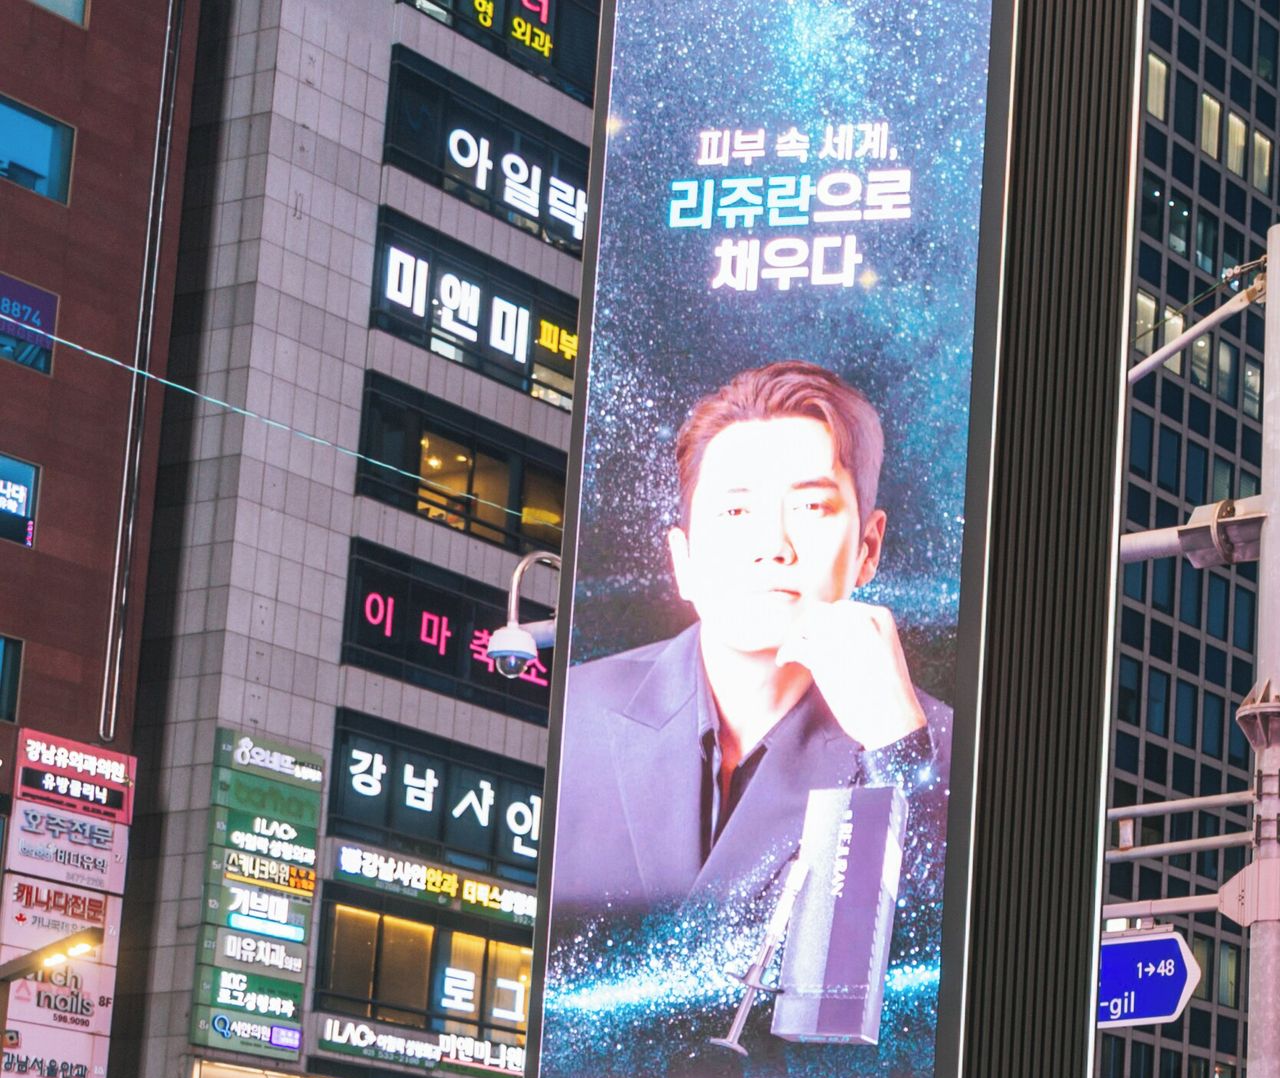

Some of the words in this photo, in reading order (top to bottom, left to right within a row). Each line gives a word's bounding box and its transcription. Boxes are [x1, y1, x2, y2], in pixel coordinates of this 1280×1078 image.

[697, 127, 766, 166] 피부
[775, 127, 811, 163] 속
[819, 122, 898, 161] 세계,
[669, 169, 912, 229] 리쥬란으로
[385, 246, 529, 363] 미앤미
[37, 990, 94, 1017] nails
